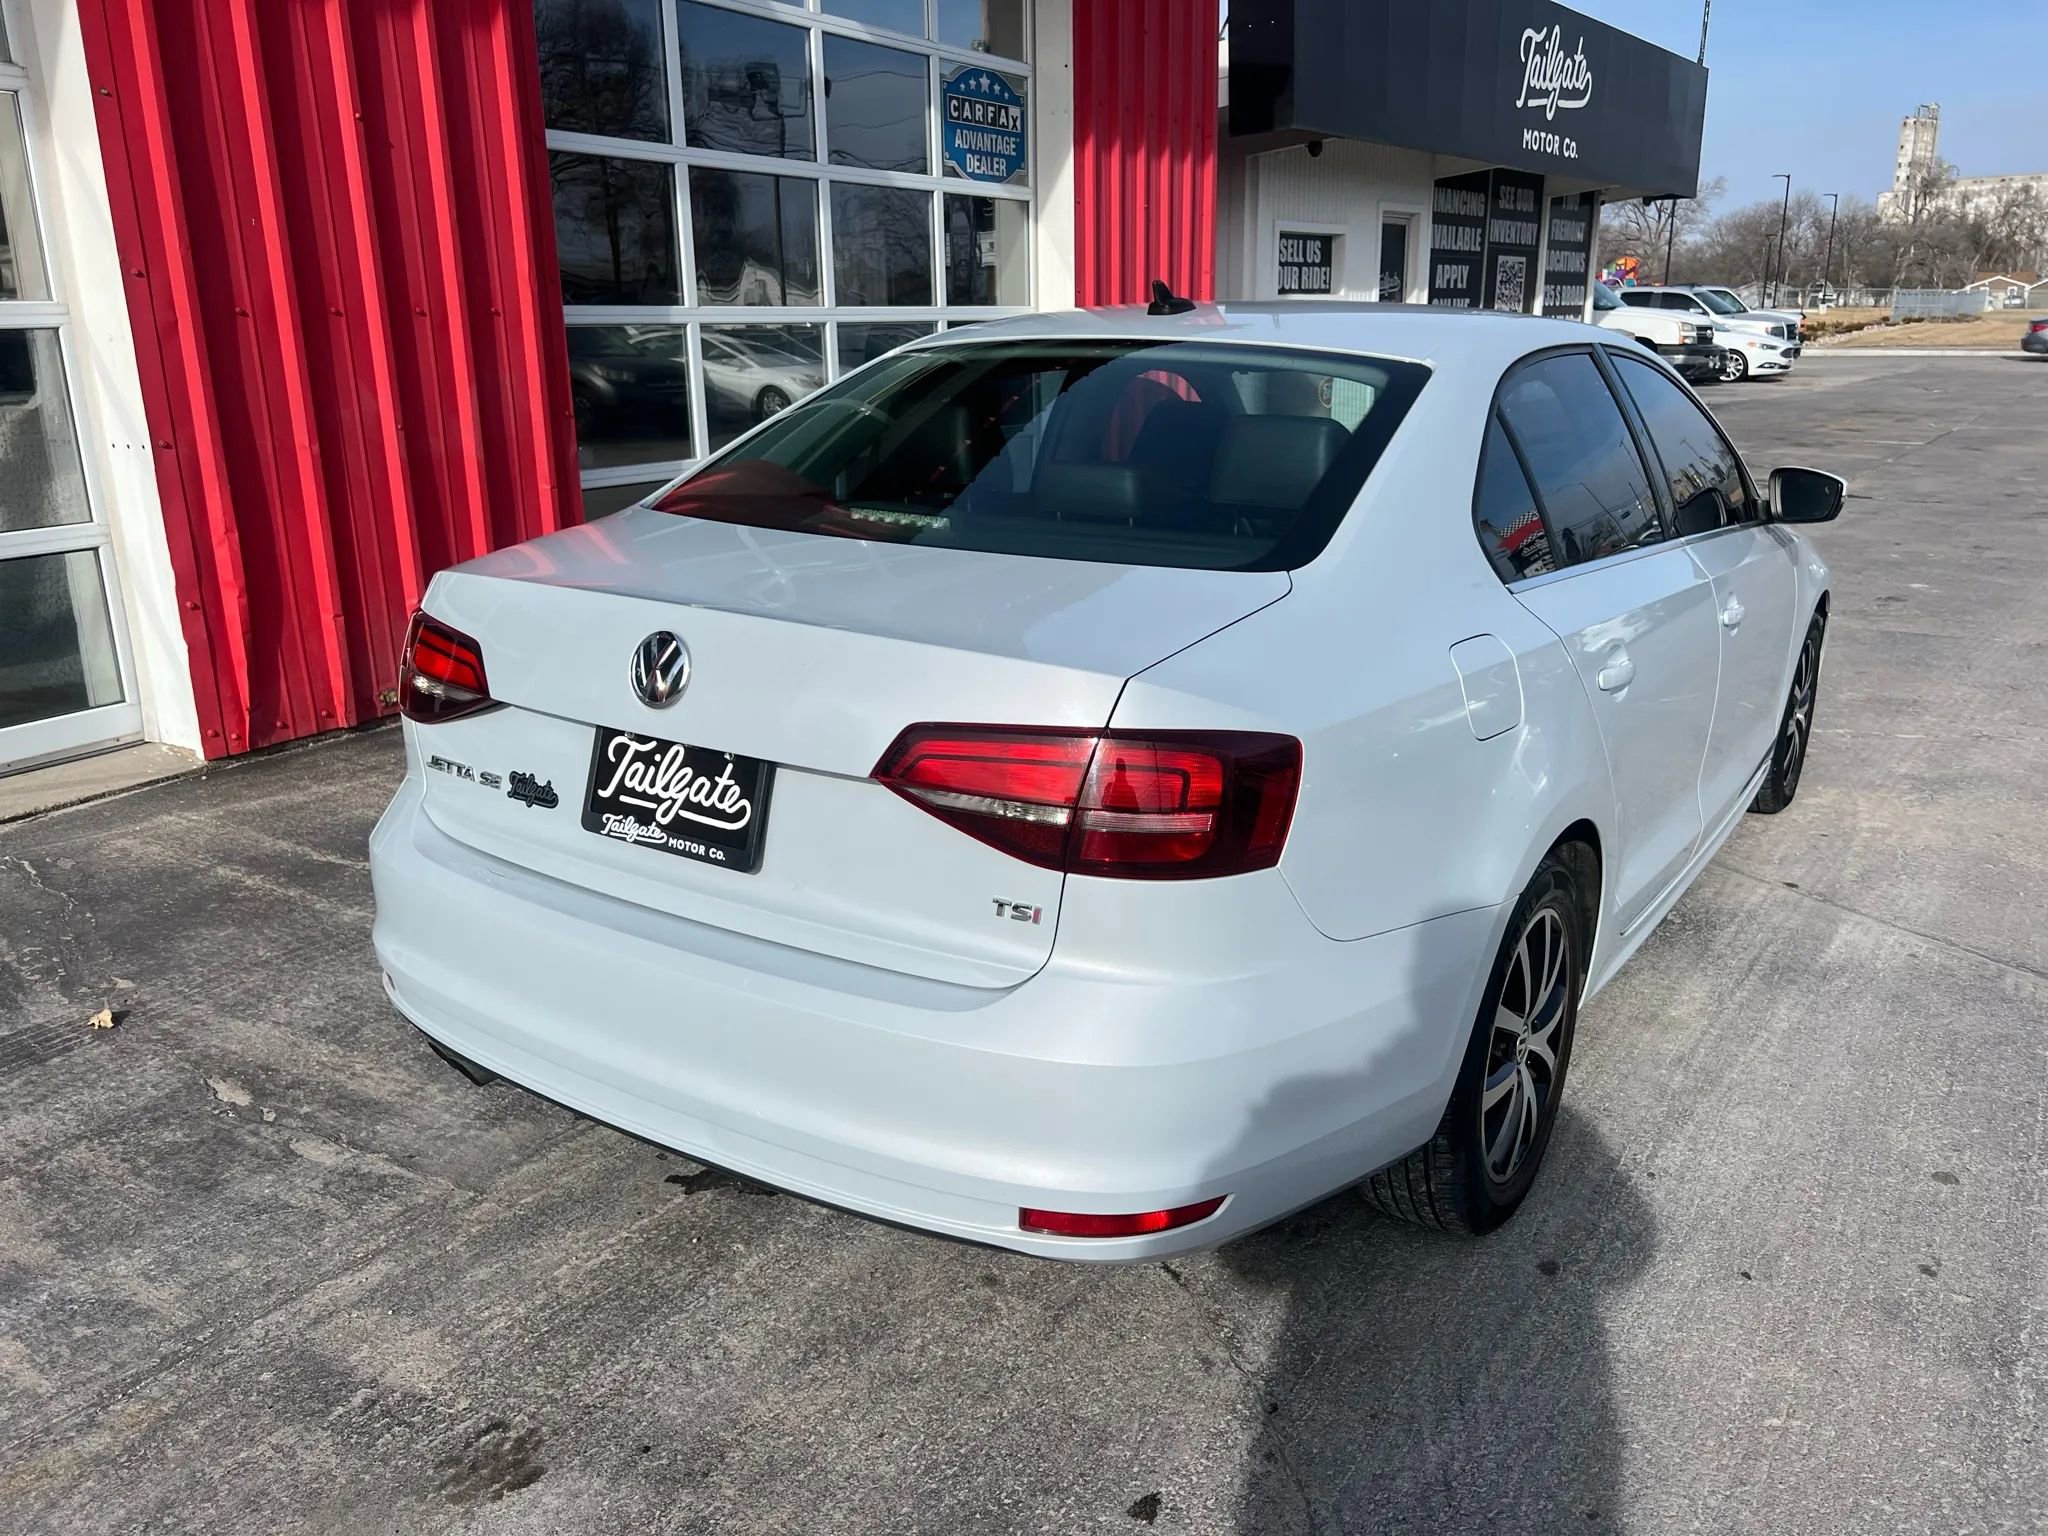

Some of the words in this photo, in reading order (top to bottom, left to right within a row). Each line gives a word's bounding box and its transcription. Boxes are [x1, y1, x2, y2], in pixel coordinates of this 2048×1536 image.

[1516, 24, 1593, 121] Tailgate
[950, 99, 1019, 132] CARFAX
[955, 128, 1017, 156] ADVANTAGE
[1522, 128, 1559, 156] MOTOR
[1563, 137, 1579, 159] CO.
[966, 154, 1007, 177] DEALER
[1434, 187, 1486, 217] INANCING
[1499, 185, 1516, 210] SEE
[1516, 188, 1535, 212] OUR
[1489, 219, 1538, 246] INVENTORY
[1280, 239, 1304, 263] SELL
[1306, 240, 1321, 264] US
[1545, 250, 1586, 273] LOCATIONS
[1278, 266, 1299, 290] OUR
[1301, 266, 1330, 289] RIDE!
[1435, 264, 1470, 289] APPLY
[426, 755, 476, 782] JETTA
[479, 771, 502, 790] SE
[598, 736, 751, 830] Tailgate
[507, 771, 559, 808] Tailgate
[600, 813, 668, 843] Tailgate
[668, 837, 705, 856] MOTOR
[709, 847, 726, 861] CO.
[992, 897, 1042, 925] TSI
